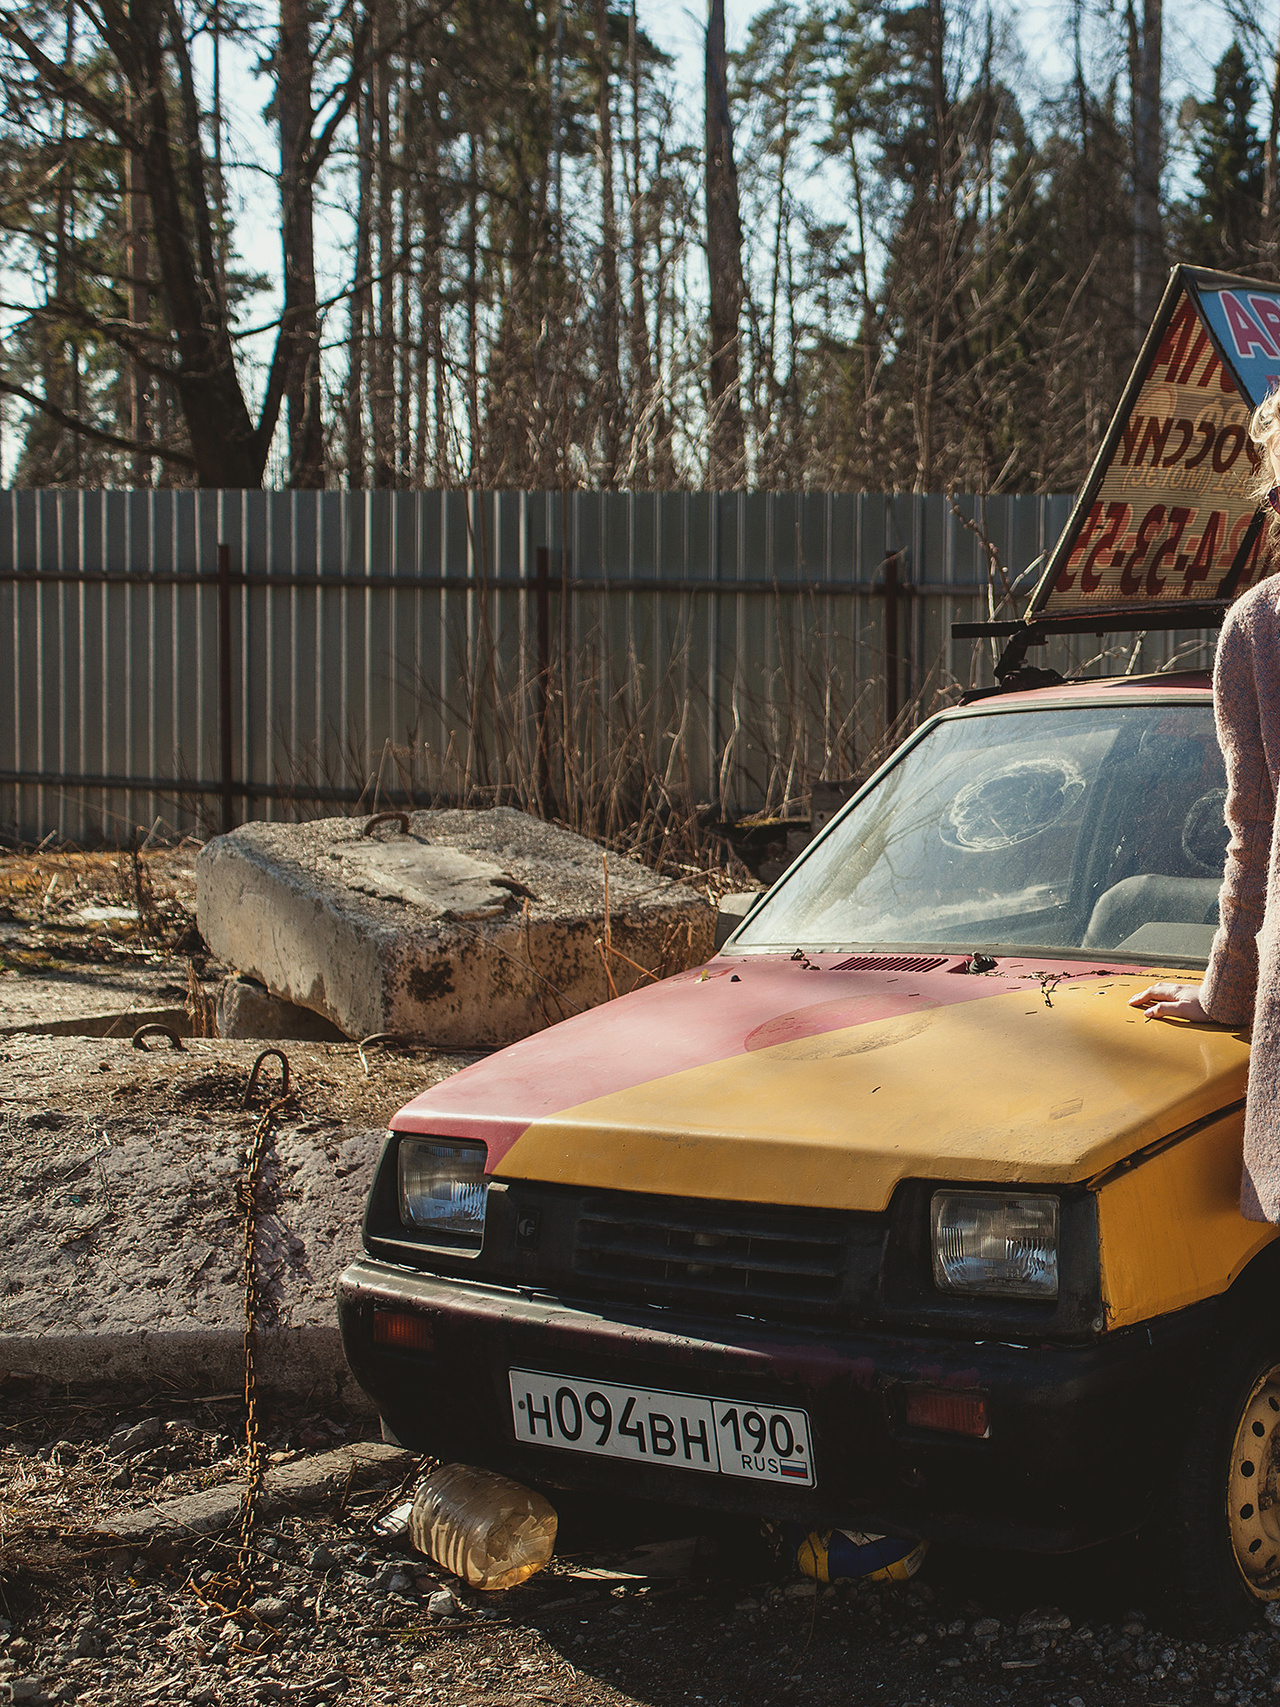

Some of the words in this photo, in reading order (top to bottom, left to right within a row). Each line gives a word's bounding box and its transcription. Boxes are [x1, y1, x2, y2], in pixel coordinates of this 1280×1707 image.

[526, 1386, 711, 1462] Н094ВН
[720, 1407, 794, 1457] 190
[741, 1454, 779, 1474] RUS
